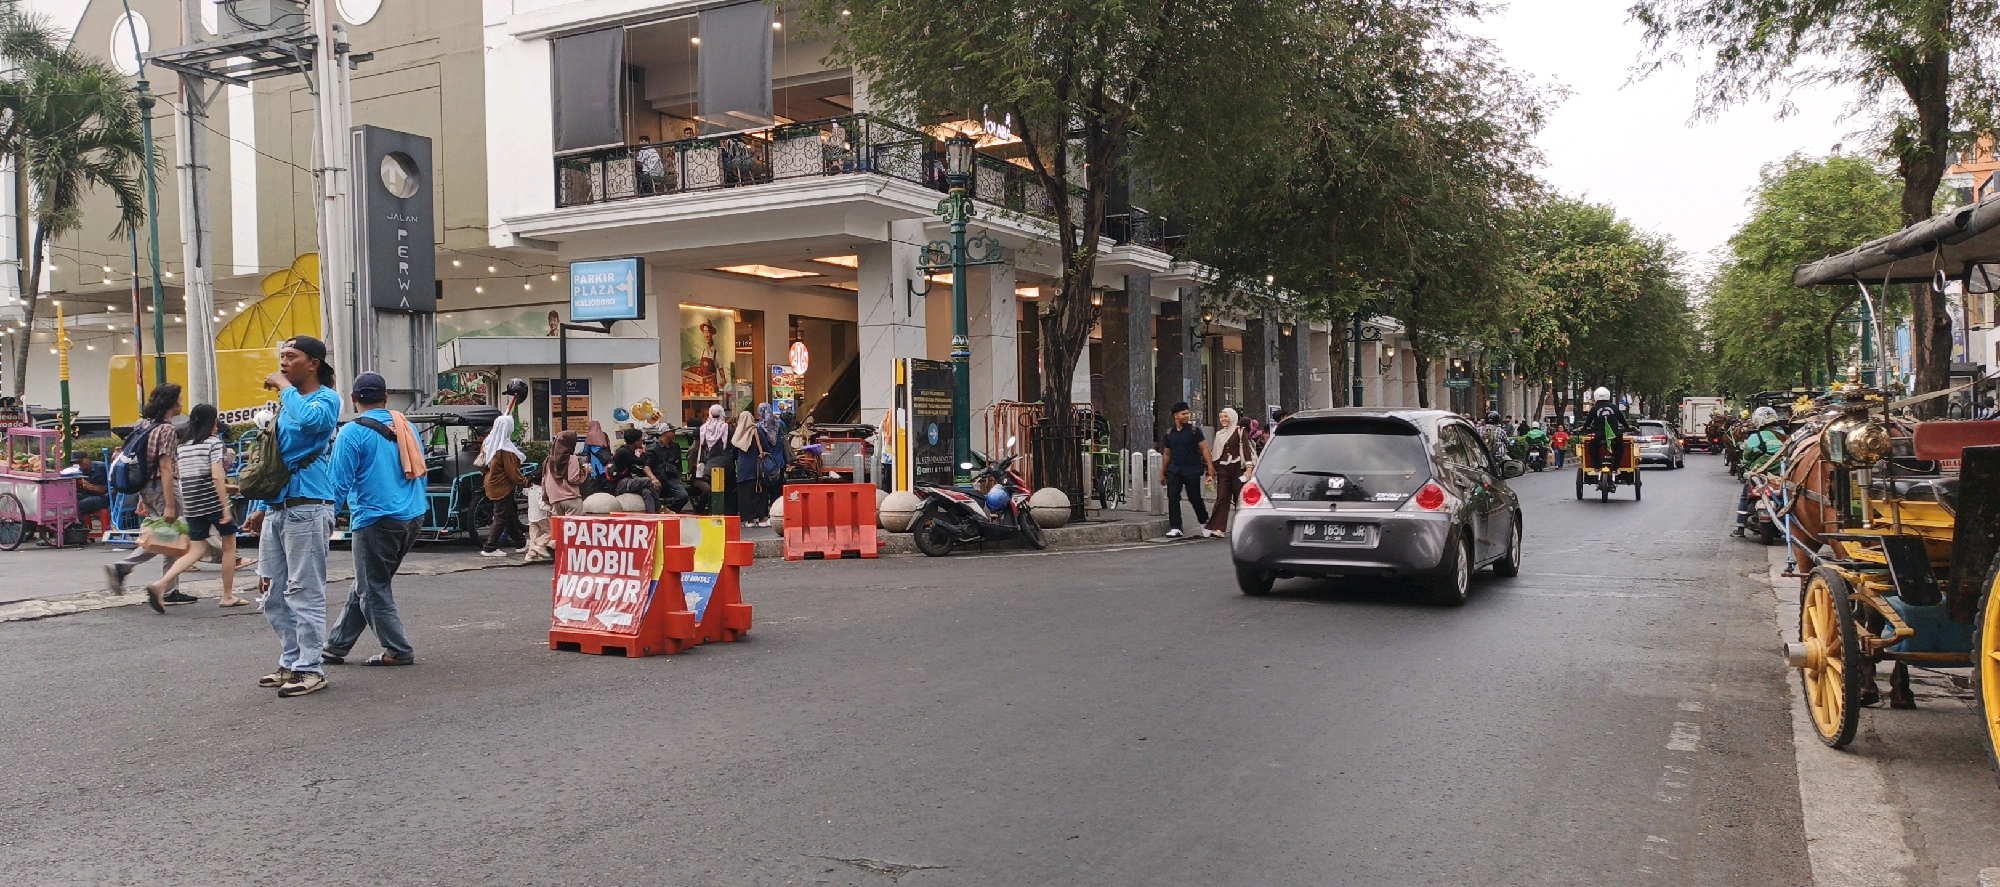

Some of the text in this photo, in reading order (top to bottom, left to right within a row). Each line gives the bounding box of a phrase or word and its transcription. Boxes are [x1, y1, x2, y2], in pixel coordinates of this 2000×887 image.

[387, 213, 418, 222] JALAN
[574, 272, 615, 284] PARKIR
[574, 285, 615, 297] PLAZA
[574, 298, 616, 307] MALIOBORO
[563, 521, 649, 549] PARKIR
[1304, 524, 1365, 536] AB 1650 JR
[567, 548, 640, 576] MOBIL
[556, 574, 641, 604] MOTOR
